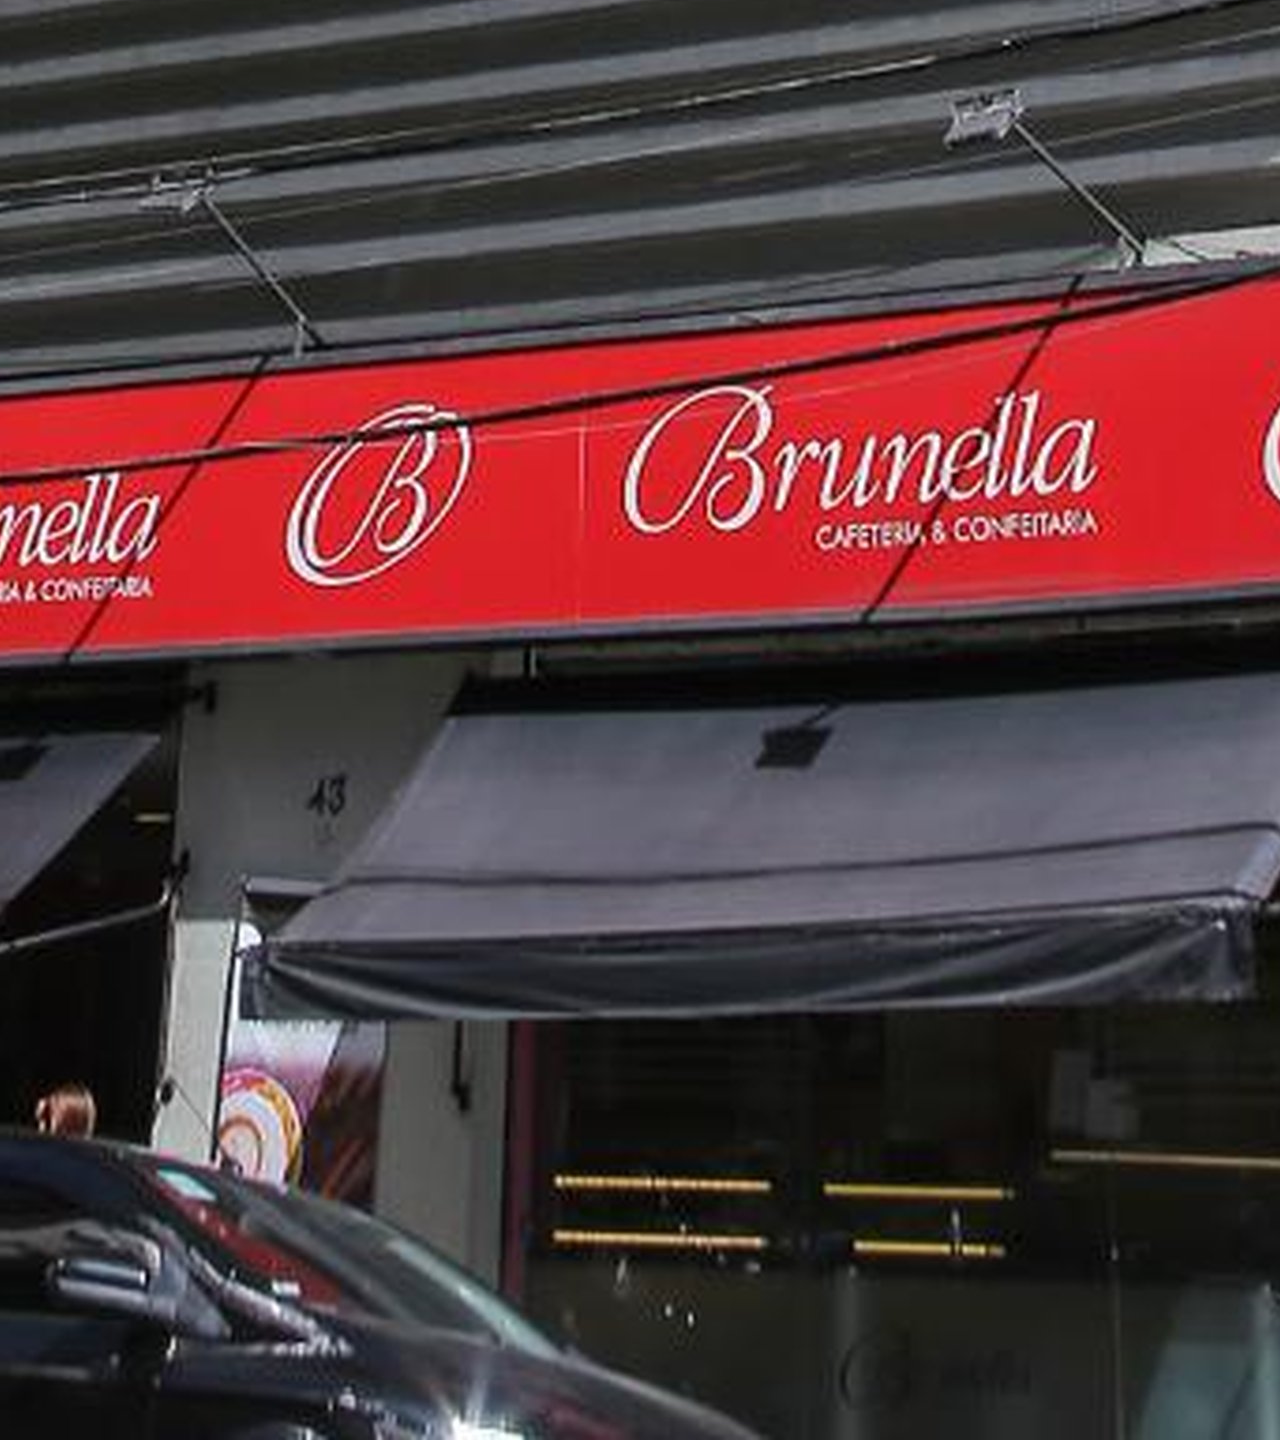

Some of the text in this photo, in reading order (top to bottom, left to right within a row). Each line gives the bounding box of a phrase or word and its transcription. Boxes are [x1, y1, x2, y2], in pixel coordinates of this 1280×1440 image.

[625, 383, 1098, 534] Brunella
[815, 509, 1099, 550] CAFETERIA & CONFEITARIA
[40, 575, 153, 602] CONFEITARIA
